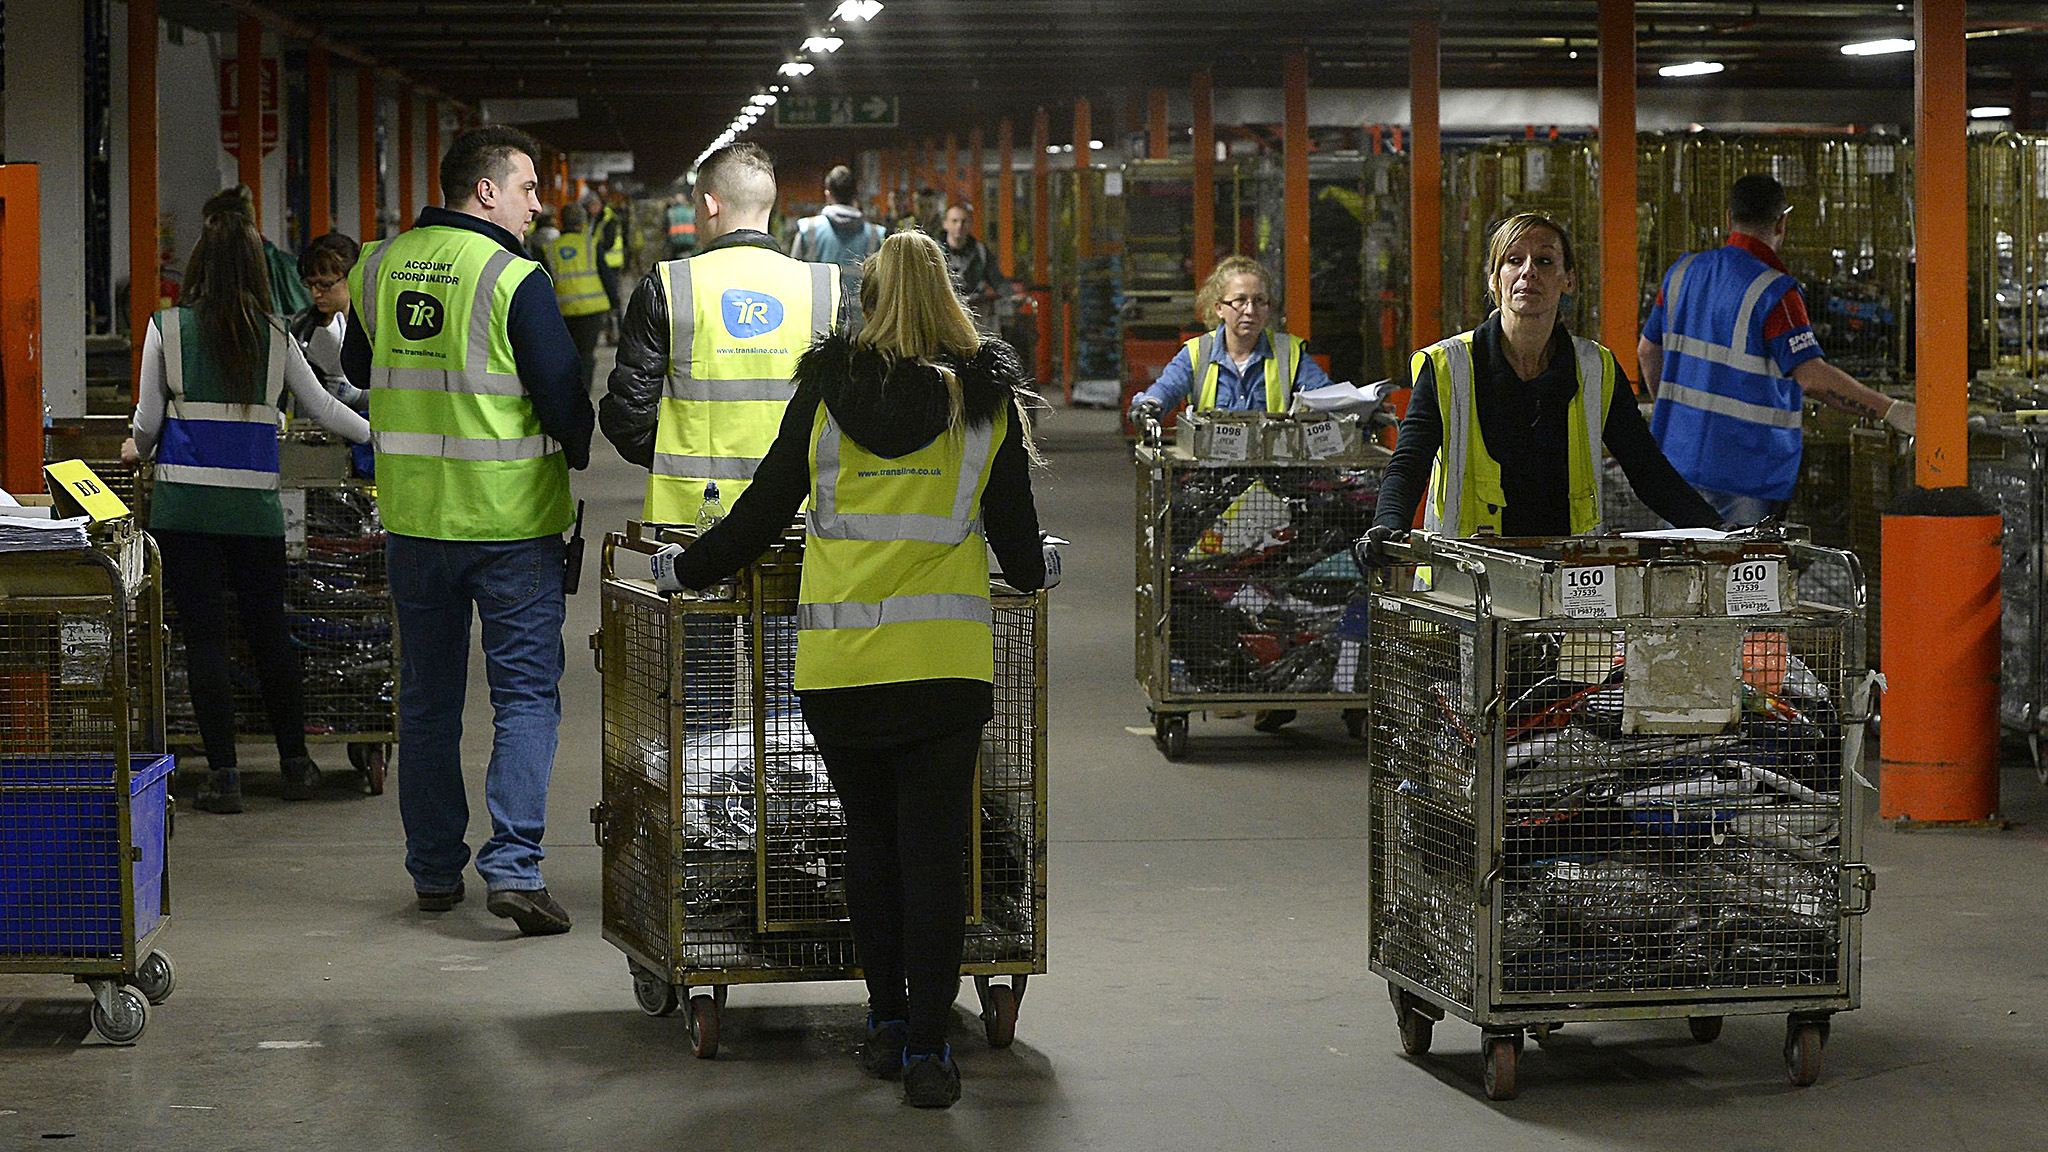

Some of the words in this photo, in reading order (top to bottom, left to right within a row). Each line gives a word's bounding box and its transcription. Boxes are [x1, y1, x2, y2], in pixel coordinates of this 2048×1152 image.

[405, 260, 452, 272] ACCOUNT
[390, 271, 459, 285] COORDINATOR
[716, 346, 789, 355] www.transline.co.uk
[1216, 426, 1241, 436] 1098
[1307, 422, 1331, 436] 1098
[858, 467, 942, 478] www.transline.co.uk
[72, 479, 101, 497] BB
[1568, 569, 1604, 587] 160
[1731, 564, 1767, 582] 160
